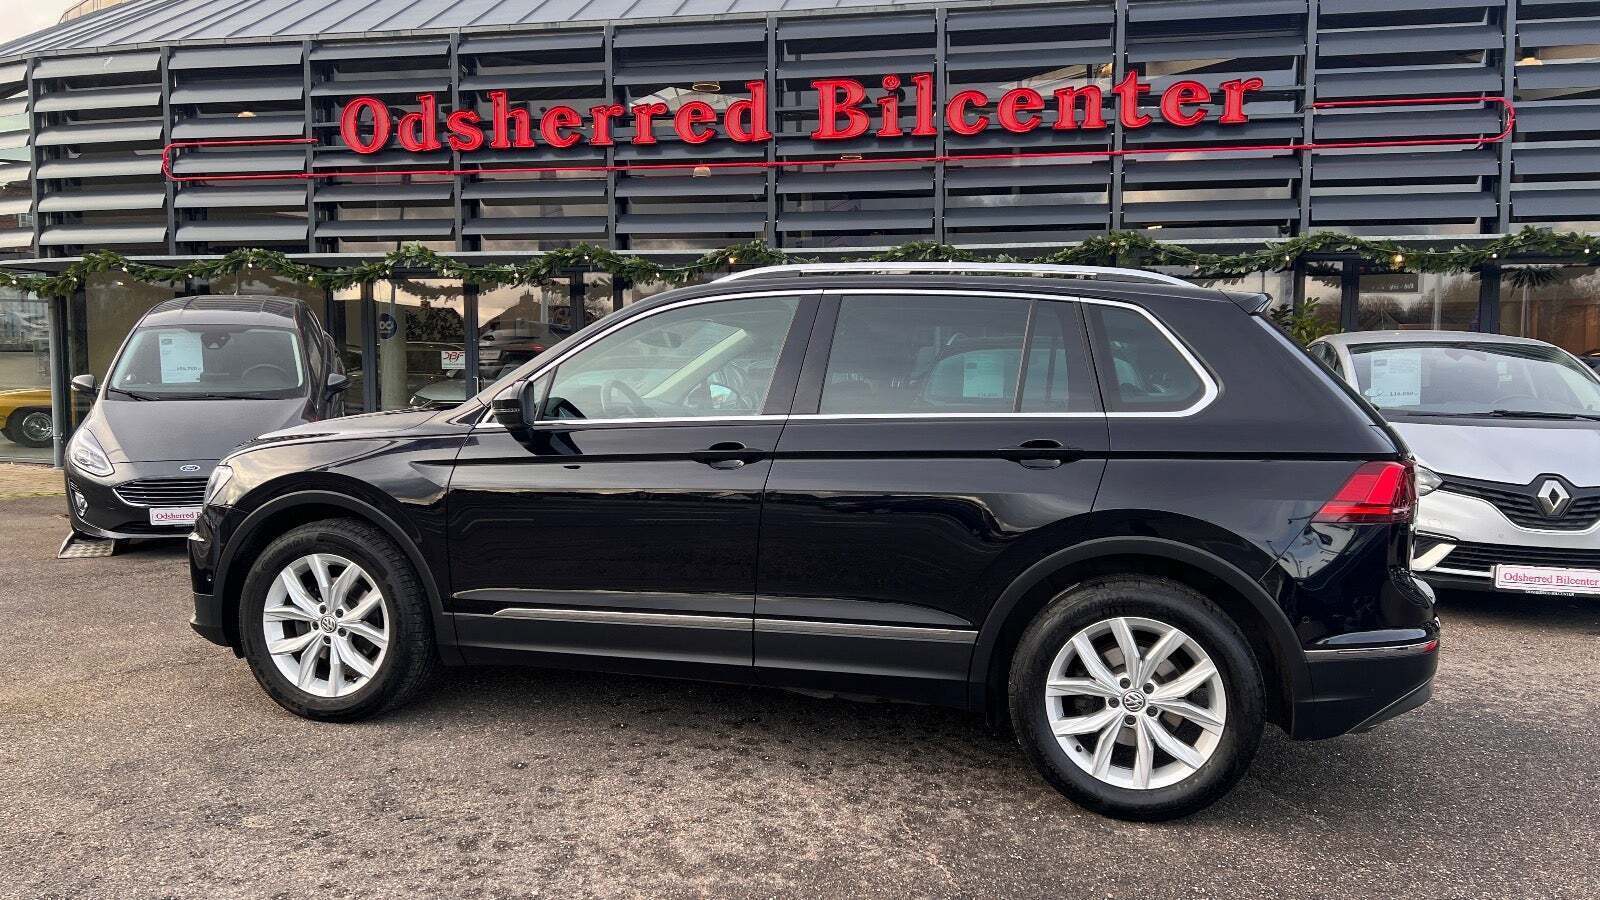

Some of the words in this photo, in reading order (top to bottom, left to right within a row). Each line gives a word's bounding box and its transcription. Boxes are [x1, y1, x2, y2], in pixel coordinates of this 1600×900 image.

[340, 79, 773, 155] Odsherred
[810, 68, 1264, 141] Bilcenter
[155, 512, 195, 520] Odsherred
[1504, 572, 1552, 583] Odsherred
[1556, 575, 1599, 586] Bilcenter
